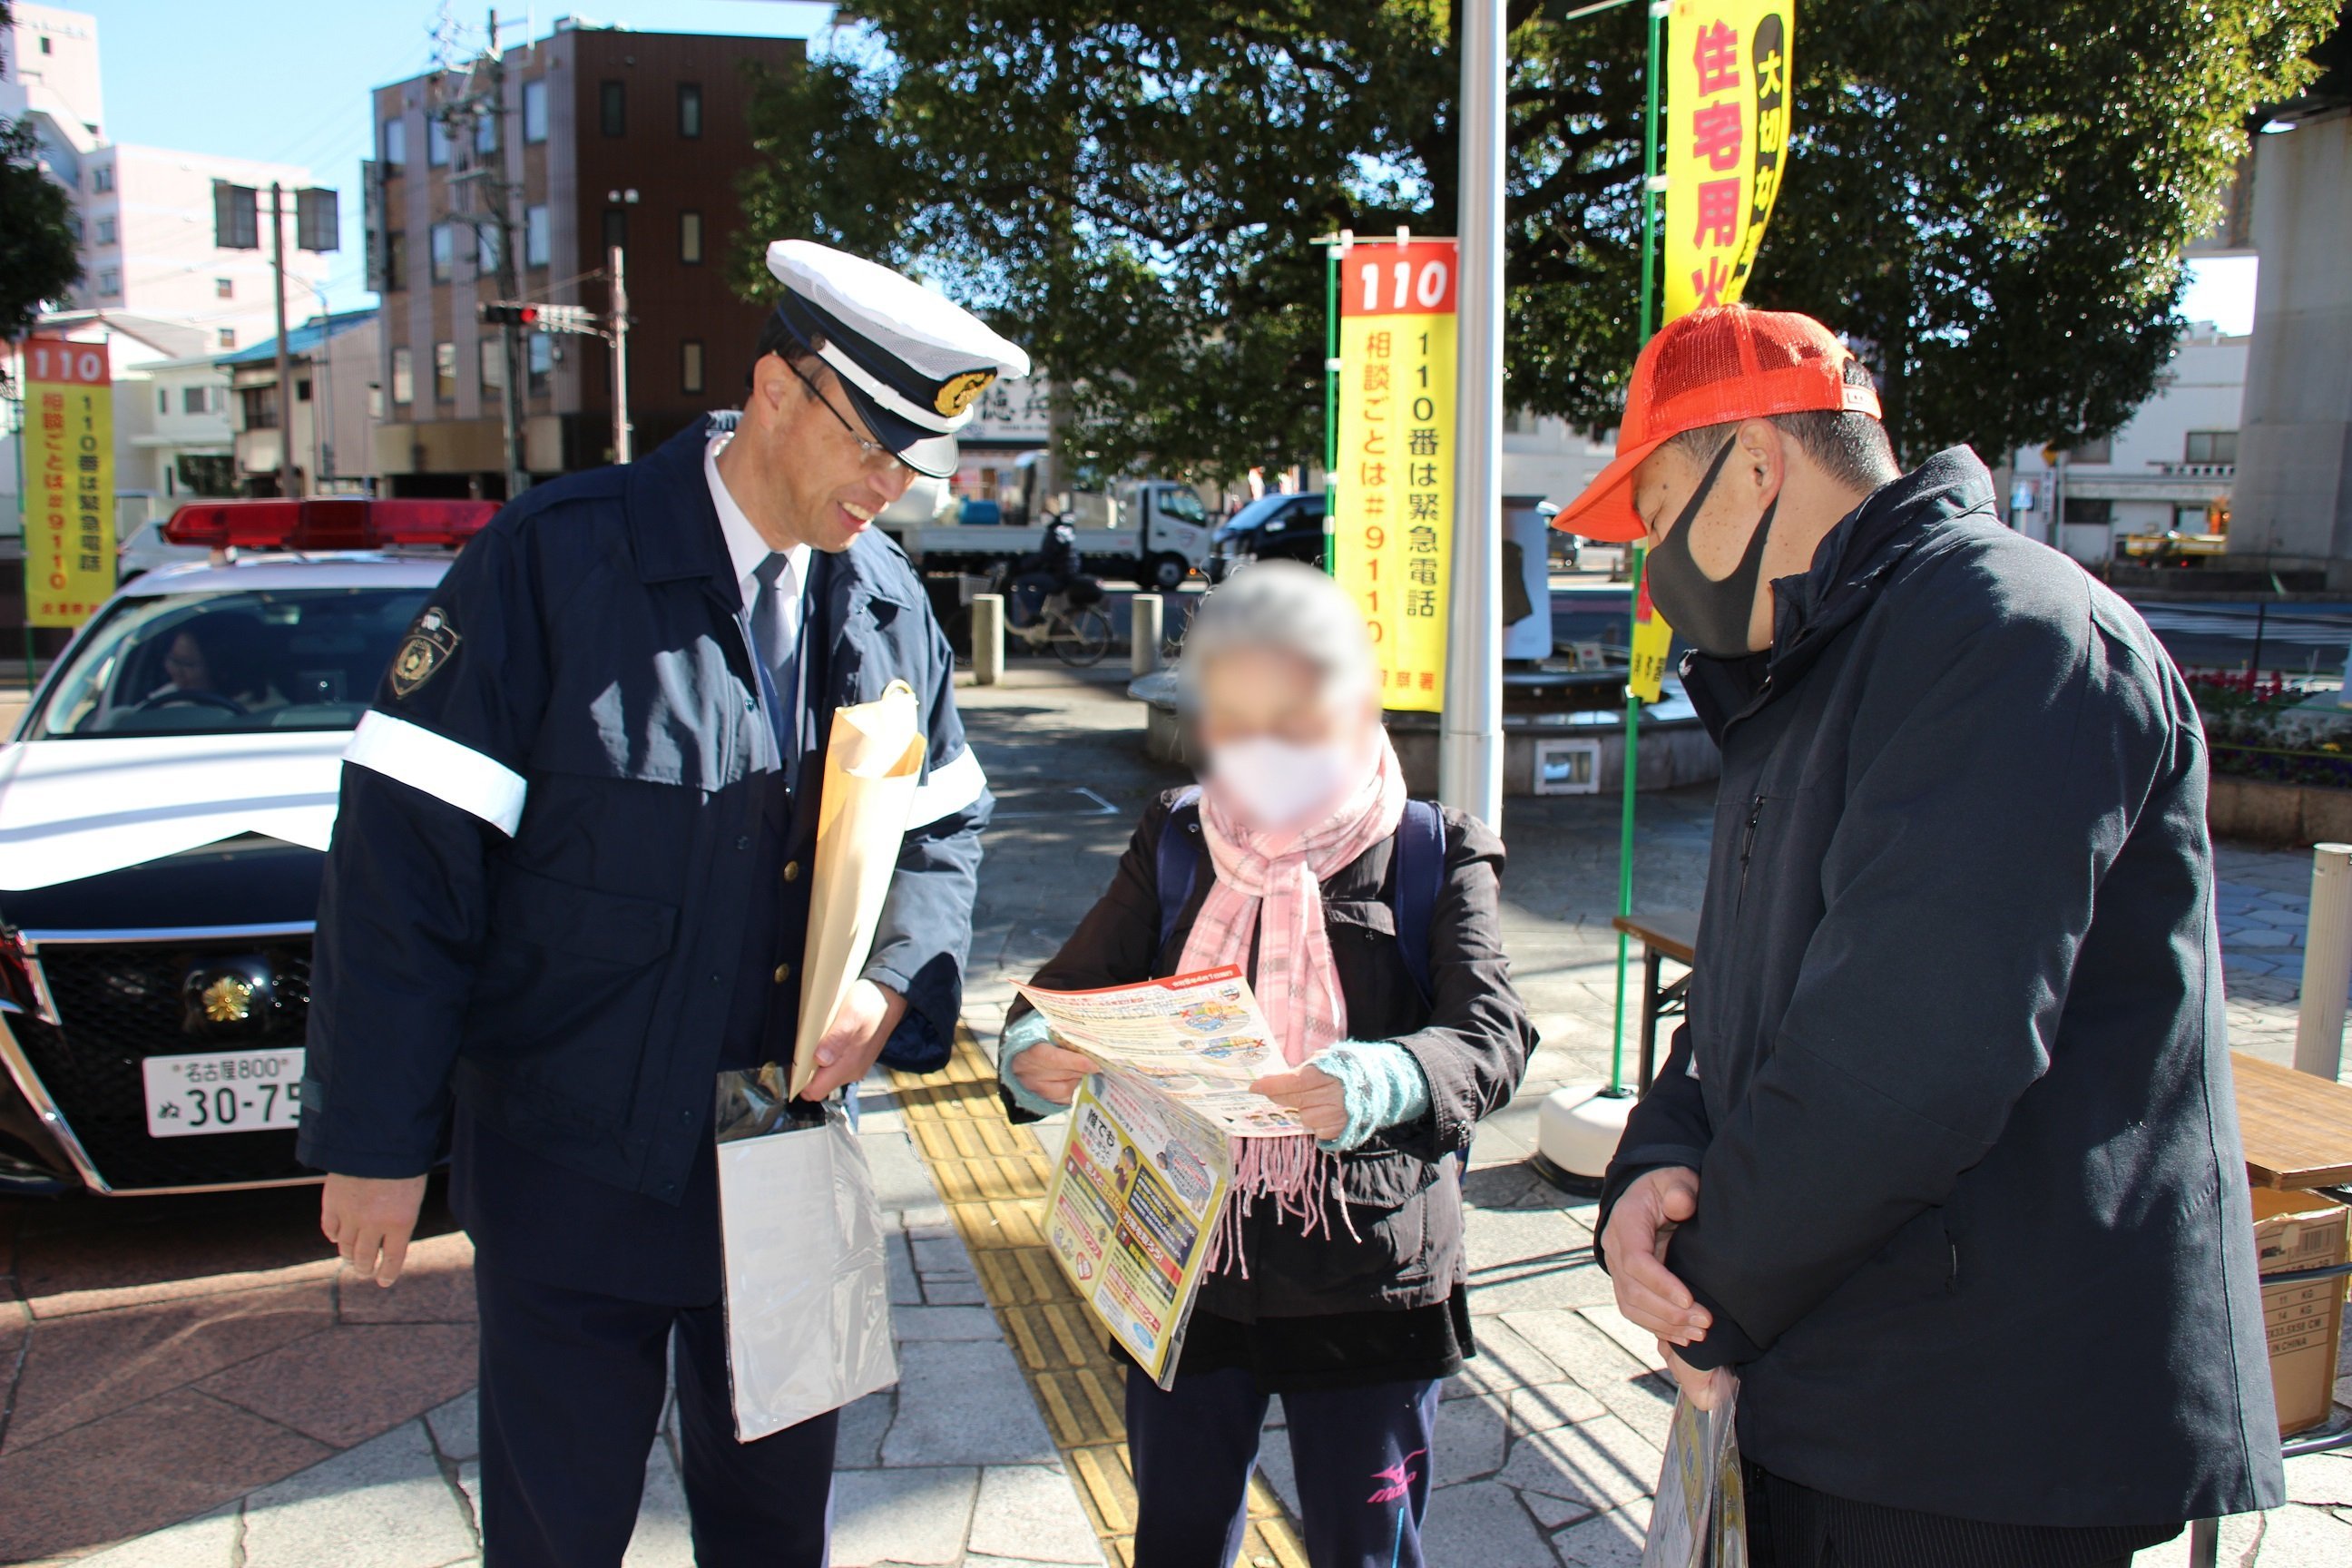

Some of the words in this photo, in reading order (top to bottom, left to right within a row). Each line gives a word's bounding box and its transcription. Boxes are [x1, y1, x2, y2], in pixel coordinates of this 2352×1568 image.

[1691, 18, 1743, 308] 住宅用火
[1361, 260, 1448, 310] 110
[35, 348, 102, 382] 110
[1407, 332, 1439, 617] 110番は緊急電話
[186, 1083, 301, 1126] 30-75
